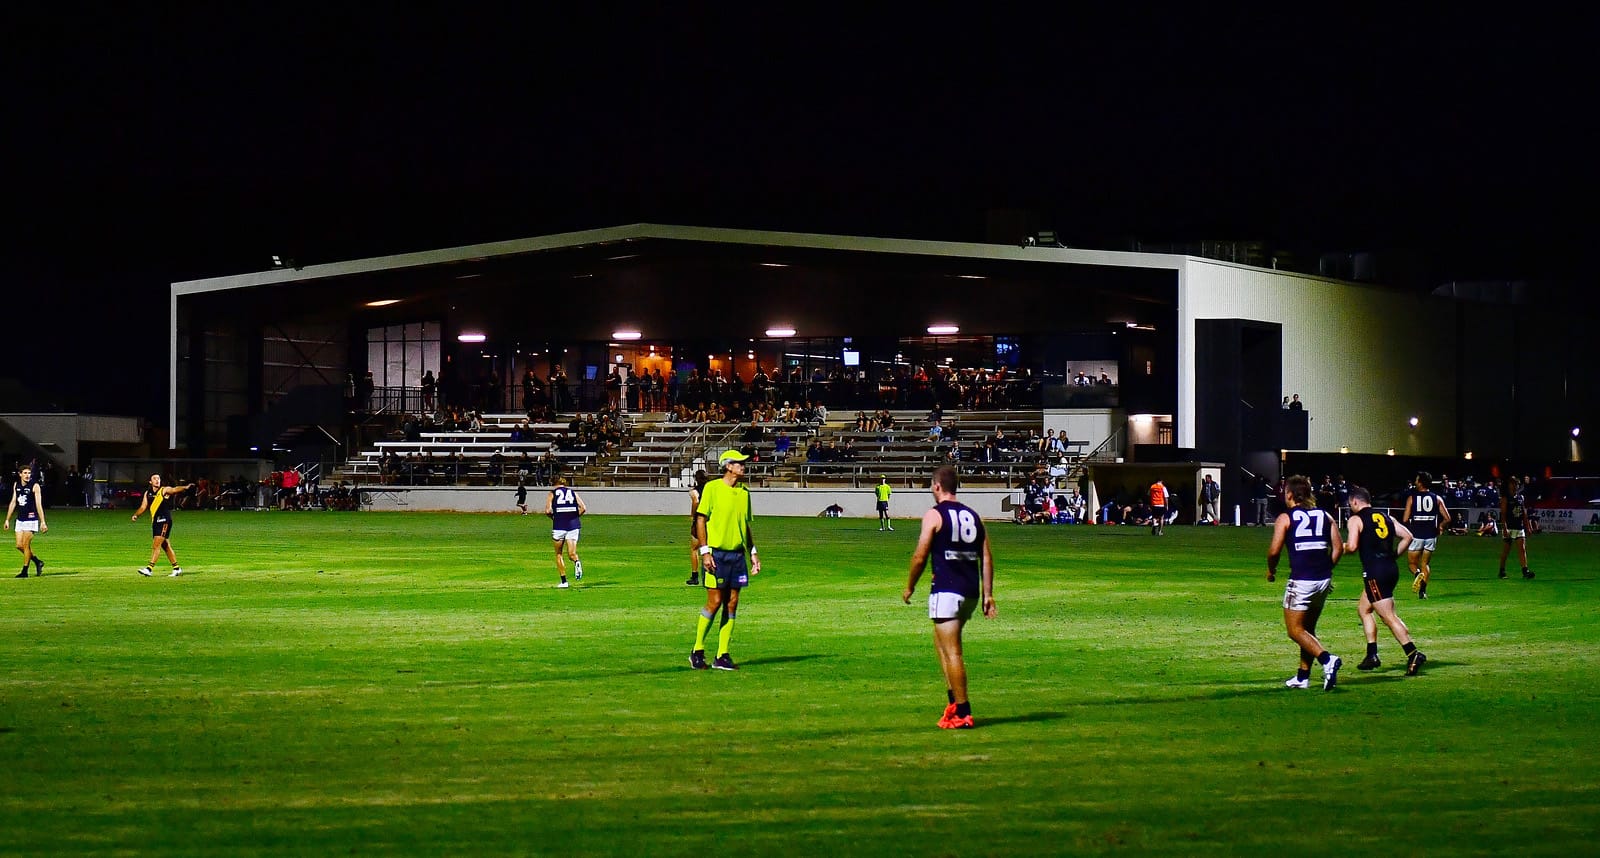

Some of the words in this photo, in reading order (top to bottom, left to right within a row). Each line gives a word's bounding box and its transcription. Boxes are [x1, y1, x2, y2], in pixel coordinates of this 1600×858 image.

[555, 489, 574, 504] 24
[1416, 495, 1434, 512] 10
[948, 509, 977, 543] 18
[1292, 509, 1324, 537] 27
[1372, 513, 1388, 539] 3
